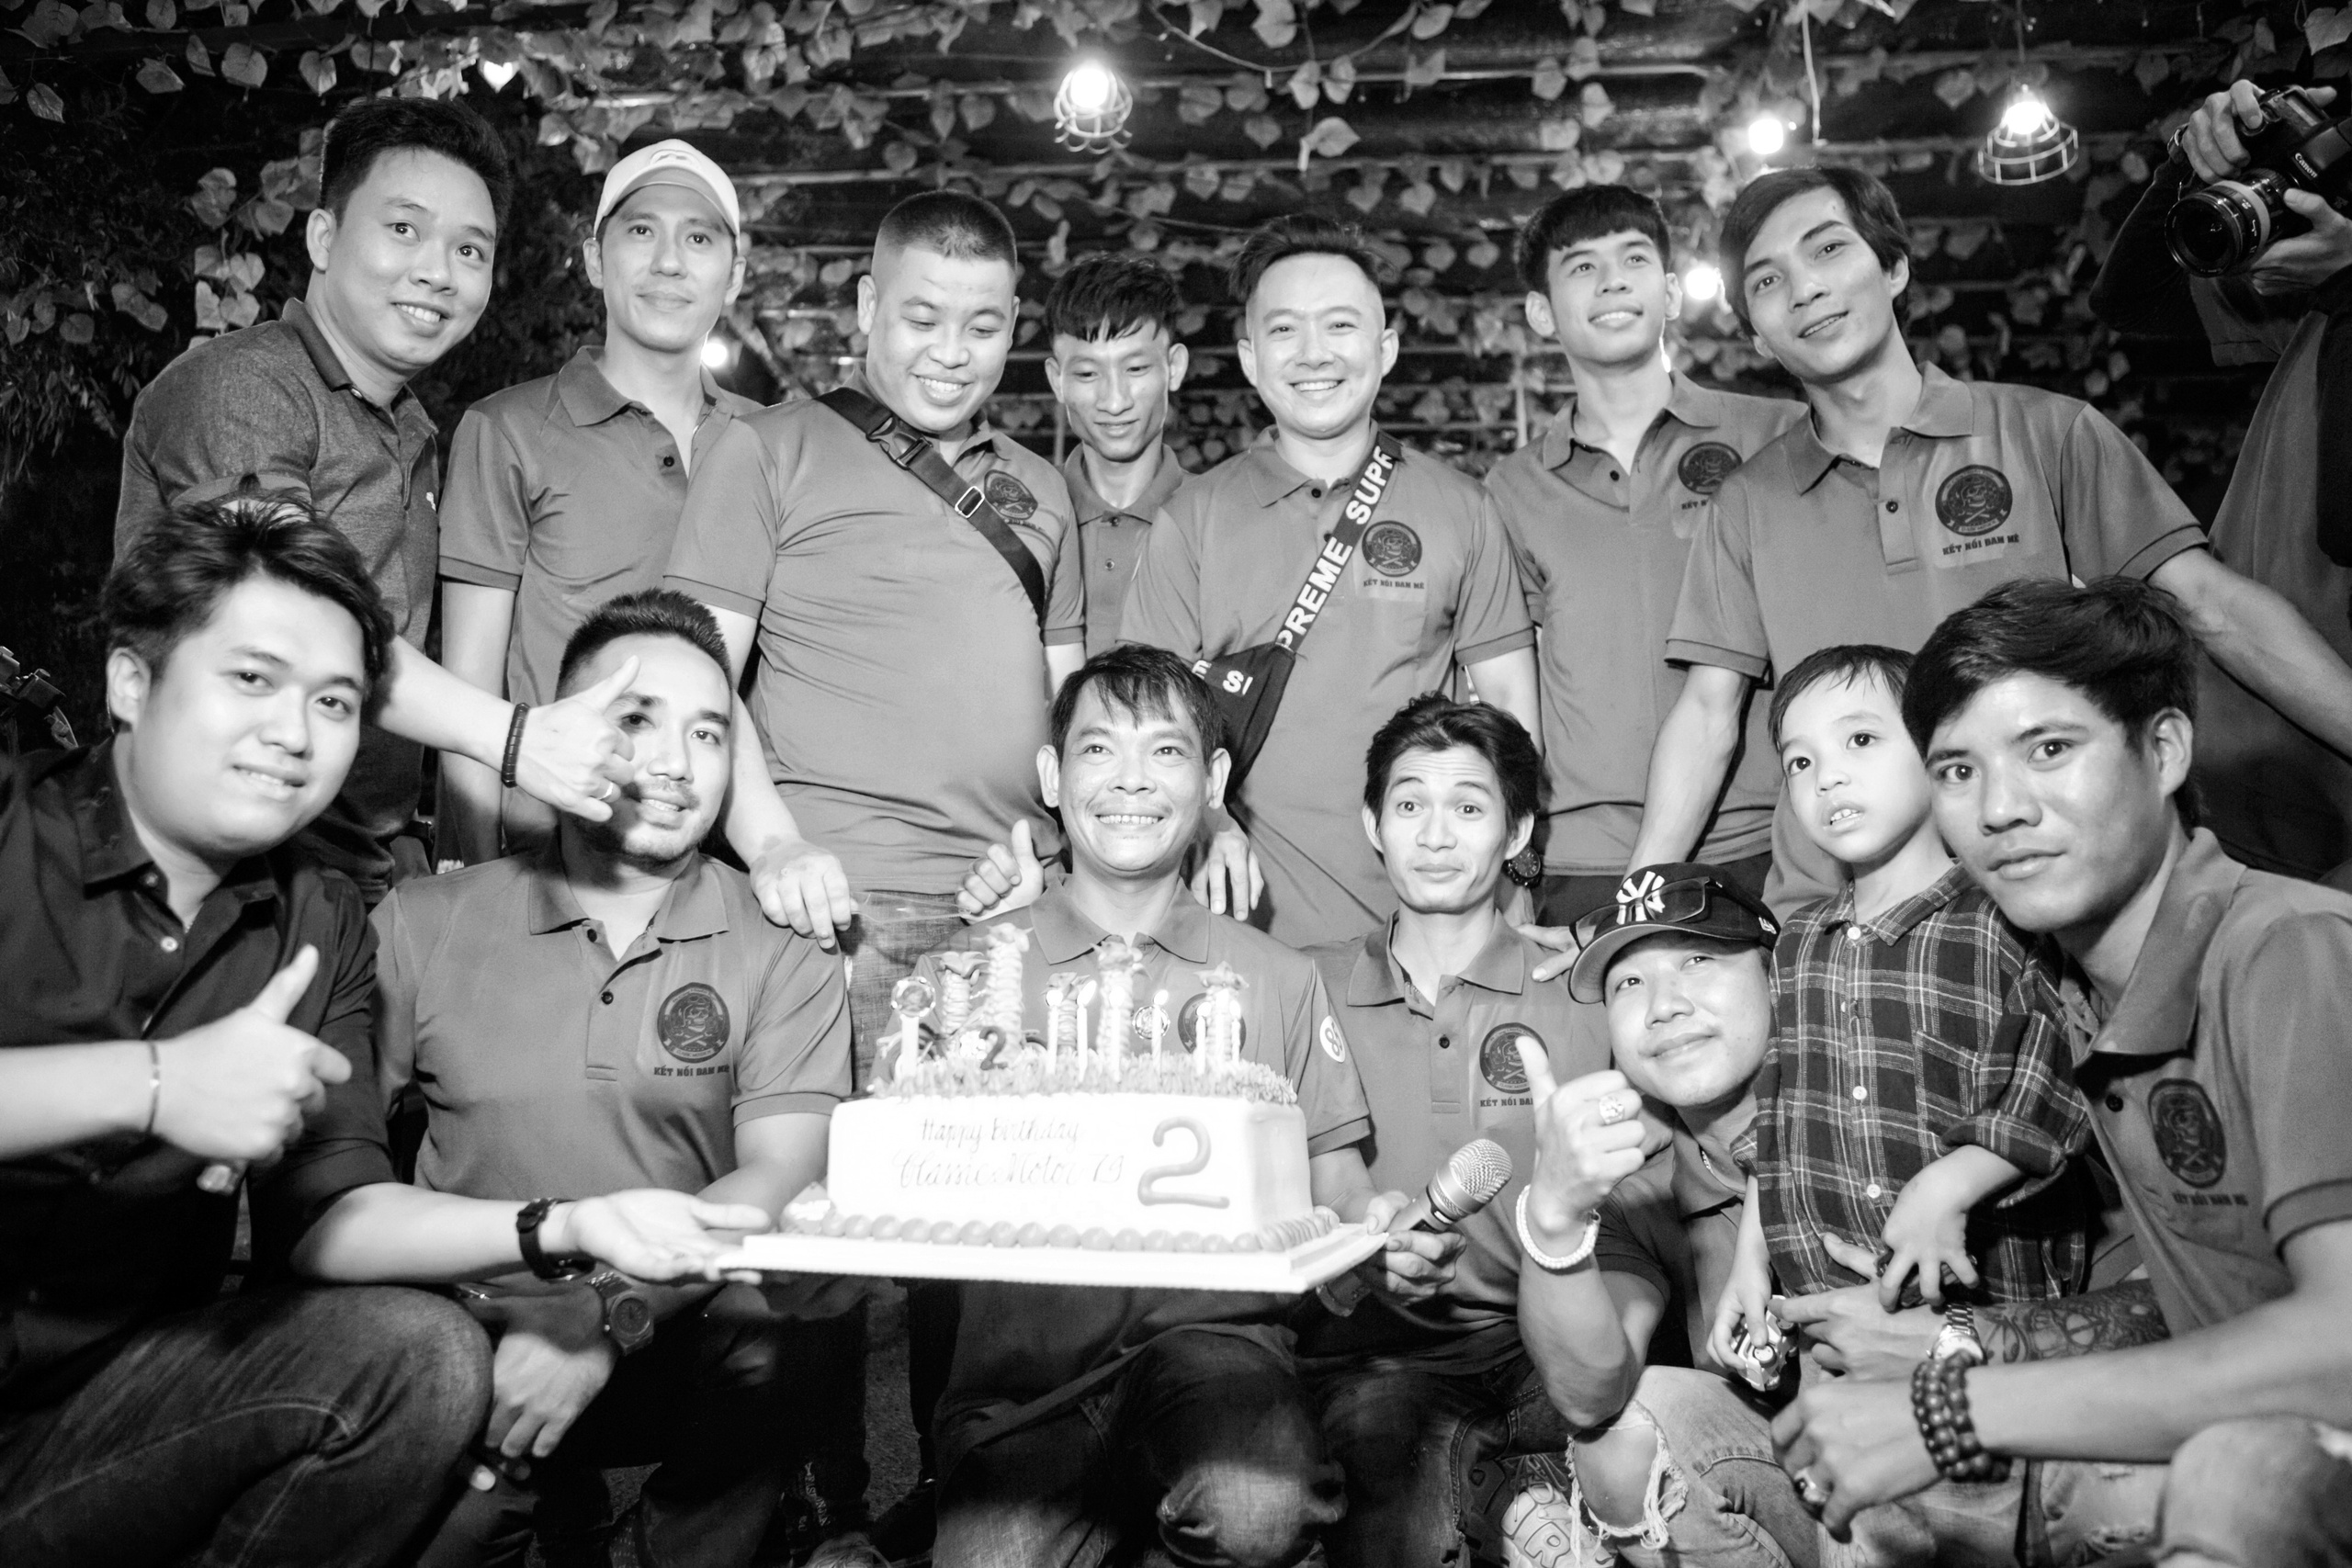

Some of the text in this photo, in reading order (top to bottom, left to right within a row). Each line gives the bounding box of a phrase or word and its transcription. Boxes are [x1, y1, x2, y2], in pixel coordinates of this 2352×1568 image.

[2295, 152, 2317, 178] Canon
[979, 1025, 1008, 1071] 2
[920, 1117, 983, 1154] Happy
[1137, 1116, 1230, 1209] 2
